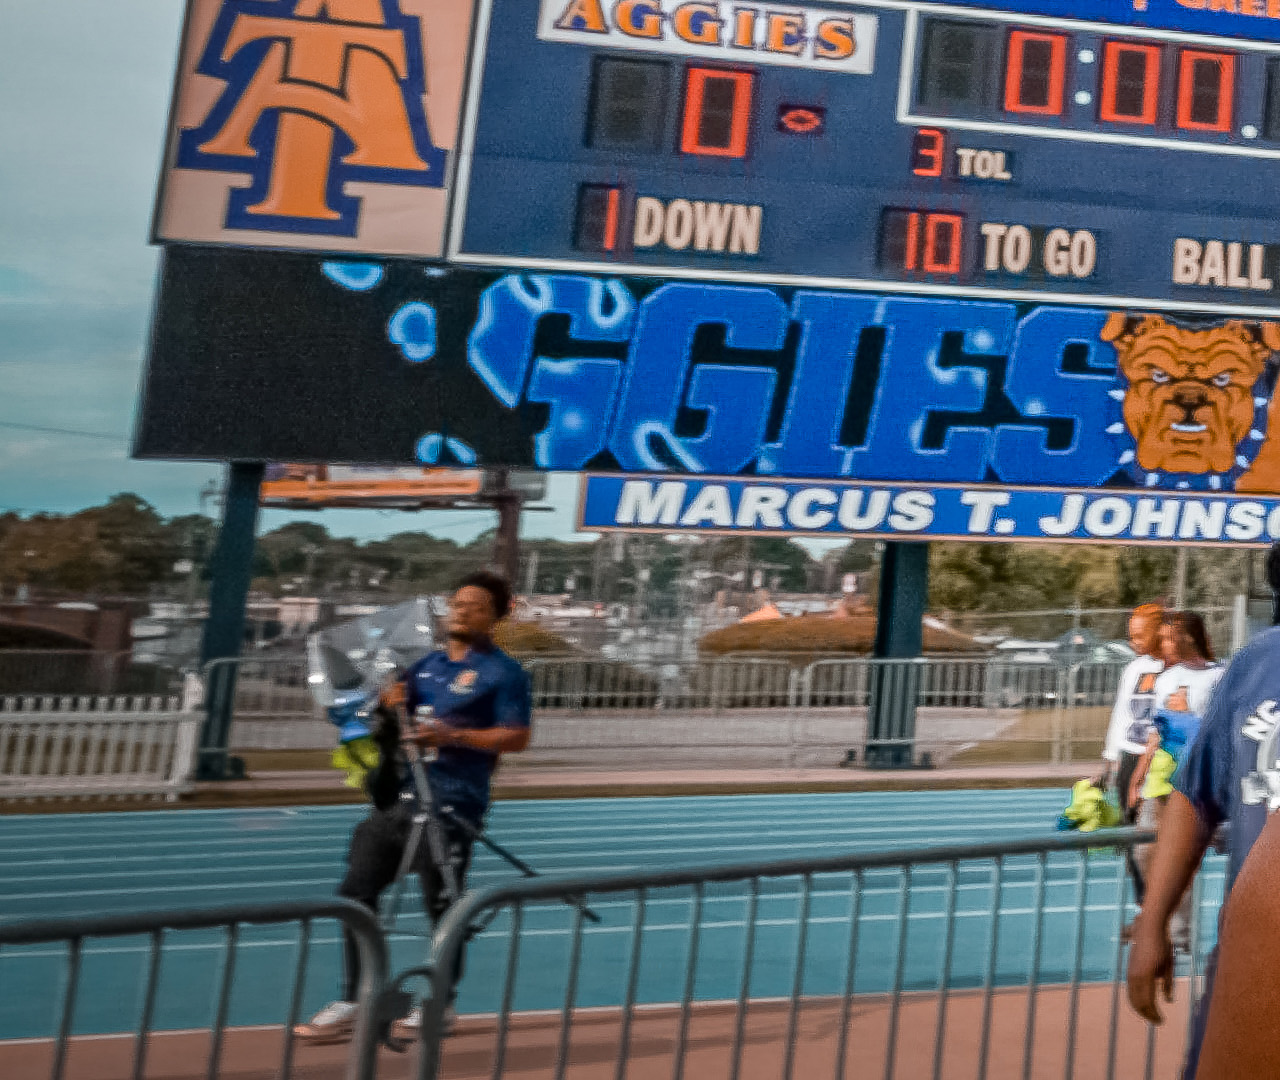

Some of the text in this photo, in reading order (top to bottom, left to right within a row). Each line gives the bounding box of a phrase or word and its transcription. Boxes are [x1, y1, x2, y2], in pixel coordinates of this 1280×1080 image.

[912, 128, 1013, 181] 3 TOL
[632, 196, 764, 255] DOWN
[905, 211, 1098, 278] 10 TO GO
[1173, 237, 1273, 294] BALL
[615, 480, 936, 531] MARCUS
[960, 489, 1017, 535] T.
